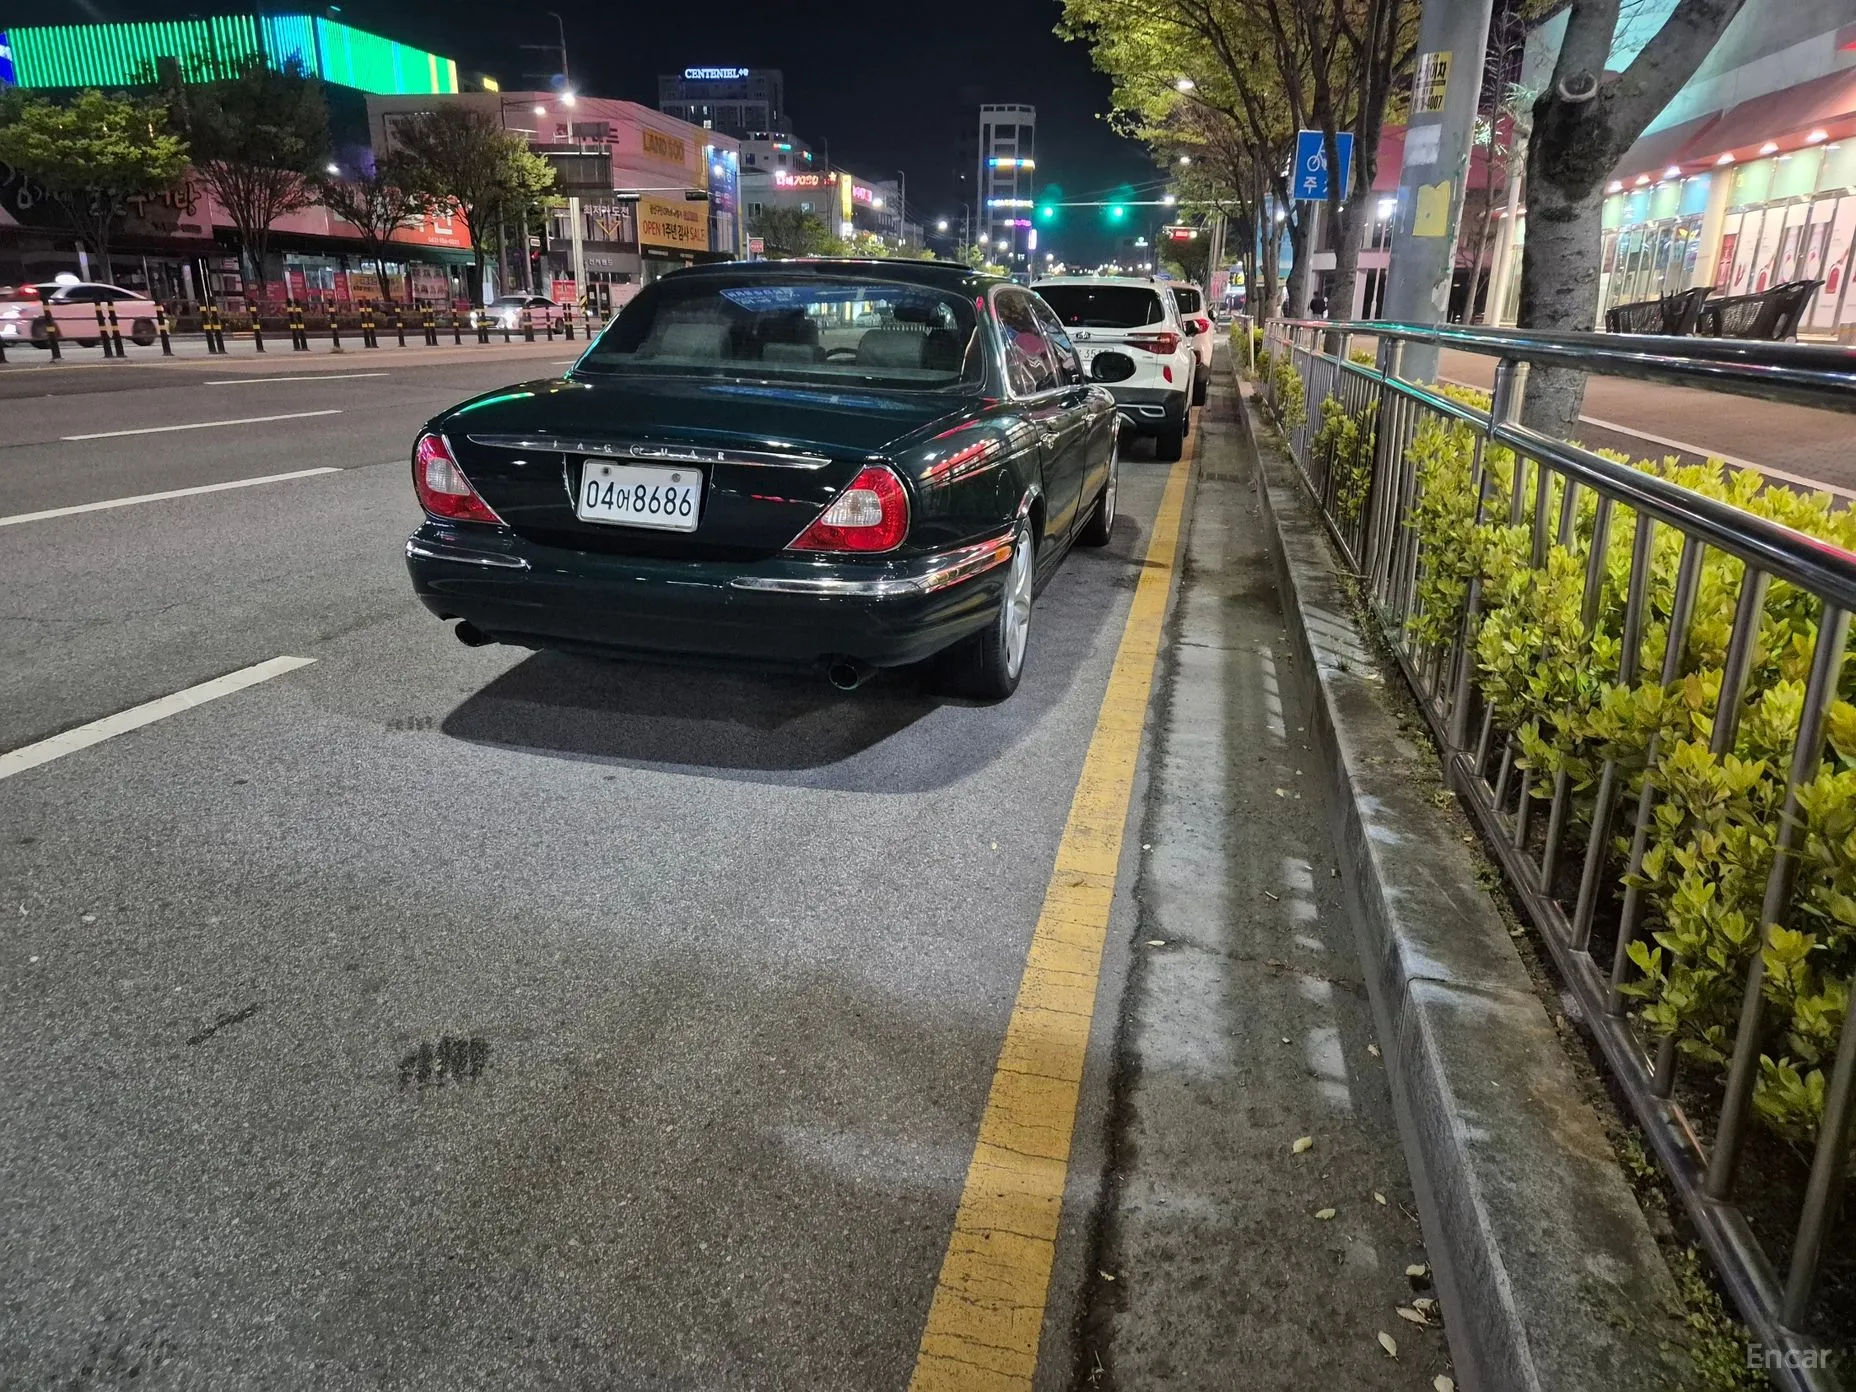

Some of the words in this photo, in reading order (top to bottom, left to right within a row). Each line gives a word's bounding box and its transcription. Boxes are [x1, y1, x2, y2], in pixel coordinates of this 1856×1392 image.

[643, 220, 661, 236] OPEN
[690, 227, 705, 241] SALE
[586, 480, 692, 517] 04어8686
